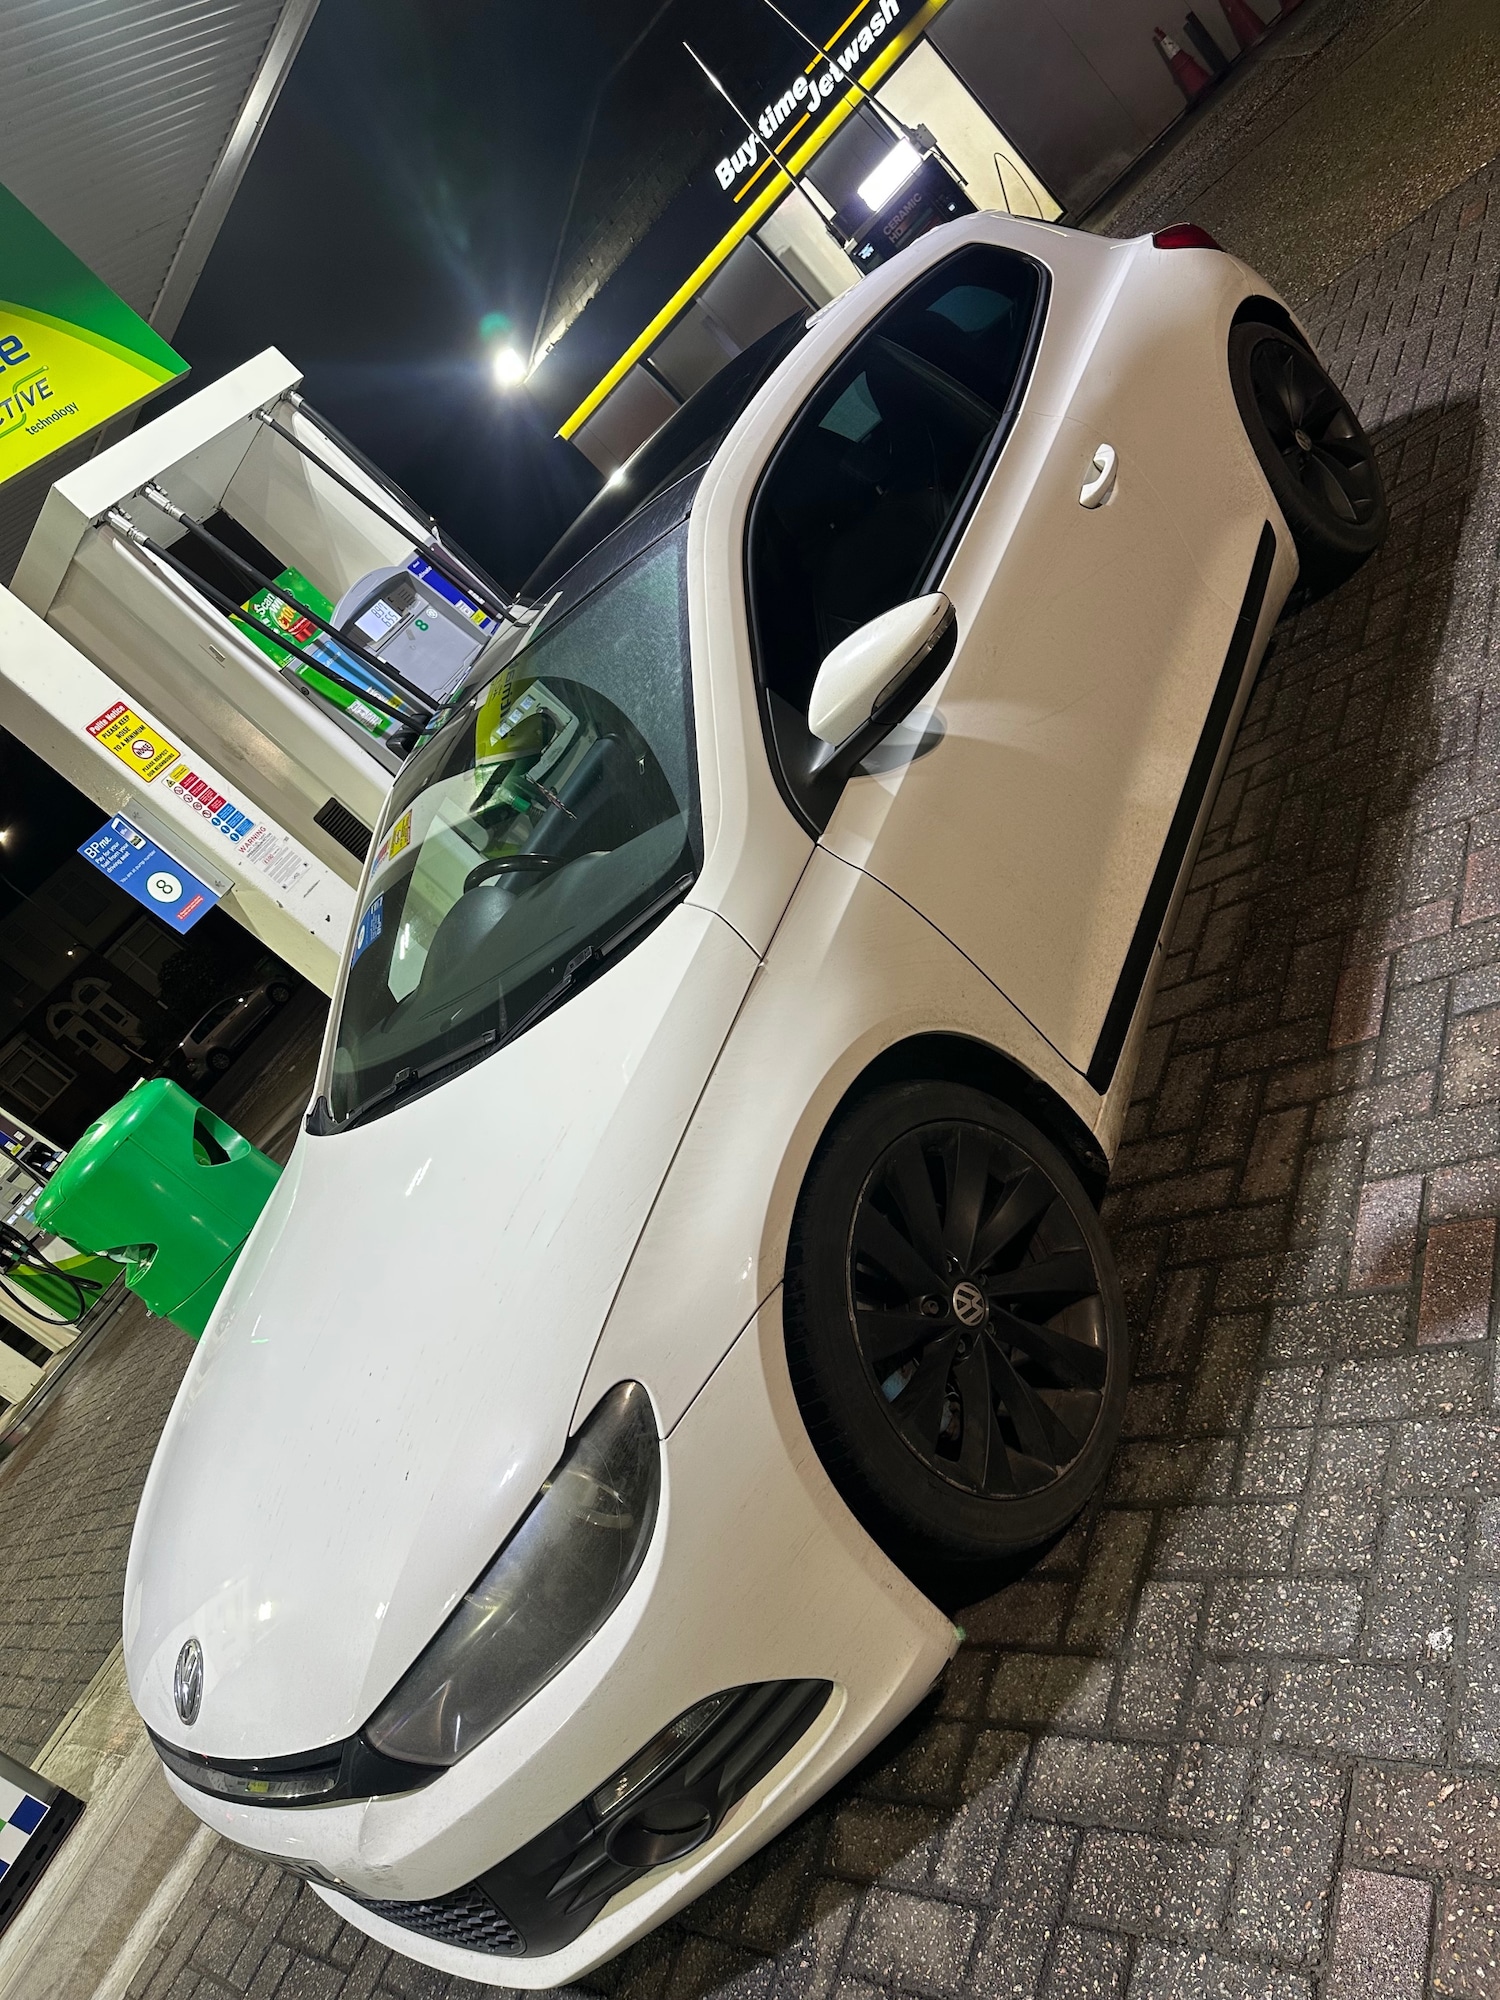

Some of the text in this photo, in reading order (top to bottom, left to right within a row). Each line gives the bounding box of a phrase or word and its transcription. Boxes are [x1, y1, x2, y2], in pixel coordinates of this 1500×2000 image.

[807, 0, 901, 113] Jetwash
[883, 192, 922, 236] CERAMIC
[0, 377, 54, 425] TIVE
[25, 401, 80, 436] technology
[255, 592, 275, 615] Scan
[415, 619, 429, 631] 8
[89, 705, 126, 734] Polite Notice
[101, 715, 130, 739] PLEASE KEEP
[113, 744, 122, 752] TO
[124, 724, 146, 743] MINIMUM
[115, 726, 131, 739] NOISE
[108, 851, 120, 861] from
[119, 842, 129, 853] your
[238, 826, 267, 853] WARNING
[95, 855, 105, 864] Pay
[110, 841, 120, 852] your
[106, 859, 123, 873] driving
[156, 879, 173, 894] 8
